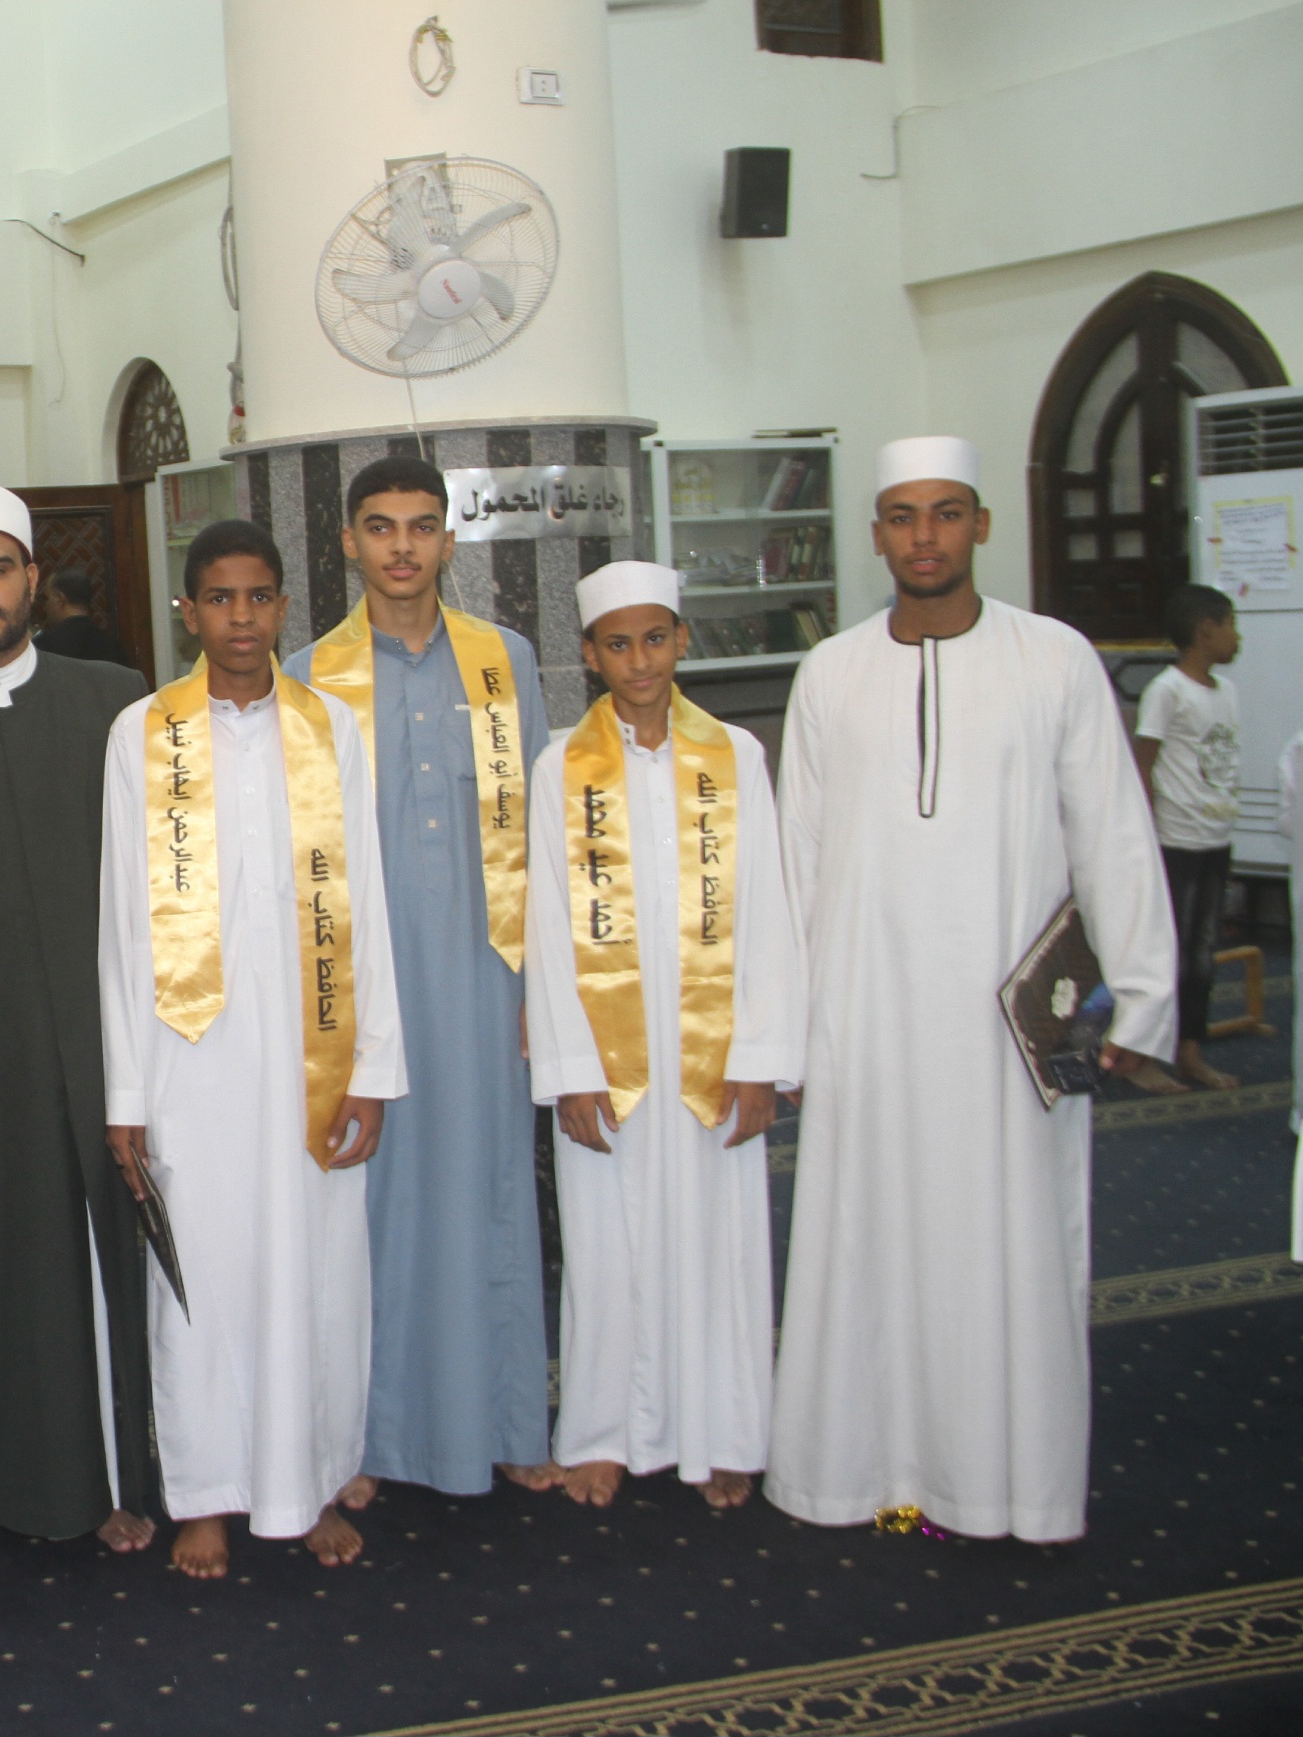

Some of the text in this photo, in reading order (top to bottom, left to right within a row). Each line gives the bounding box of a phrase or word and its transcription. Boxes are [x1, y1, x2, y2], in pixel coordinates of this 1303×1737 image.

[461, 484, 624, 521] رجاء غلق المحمول
[481, 668, 500, 695] عطا
[165, 713, 192, 747] نبيل
[485, 702, 510, 753] العباس
[492, 784, 515, 829] يوسف
[579, 784, 632, 945] أحمد عيد محمد
[692, 772, 719, 945] الحافظ كتاب الله
[308, 849, 337, 1031] الحافظ كتاب الله
